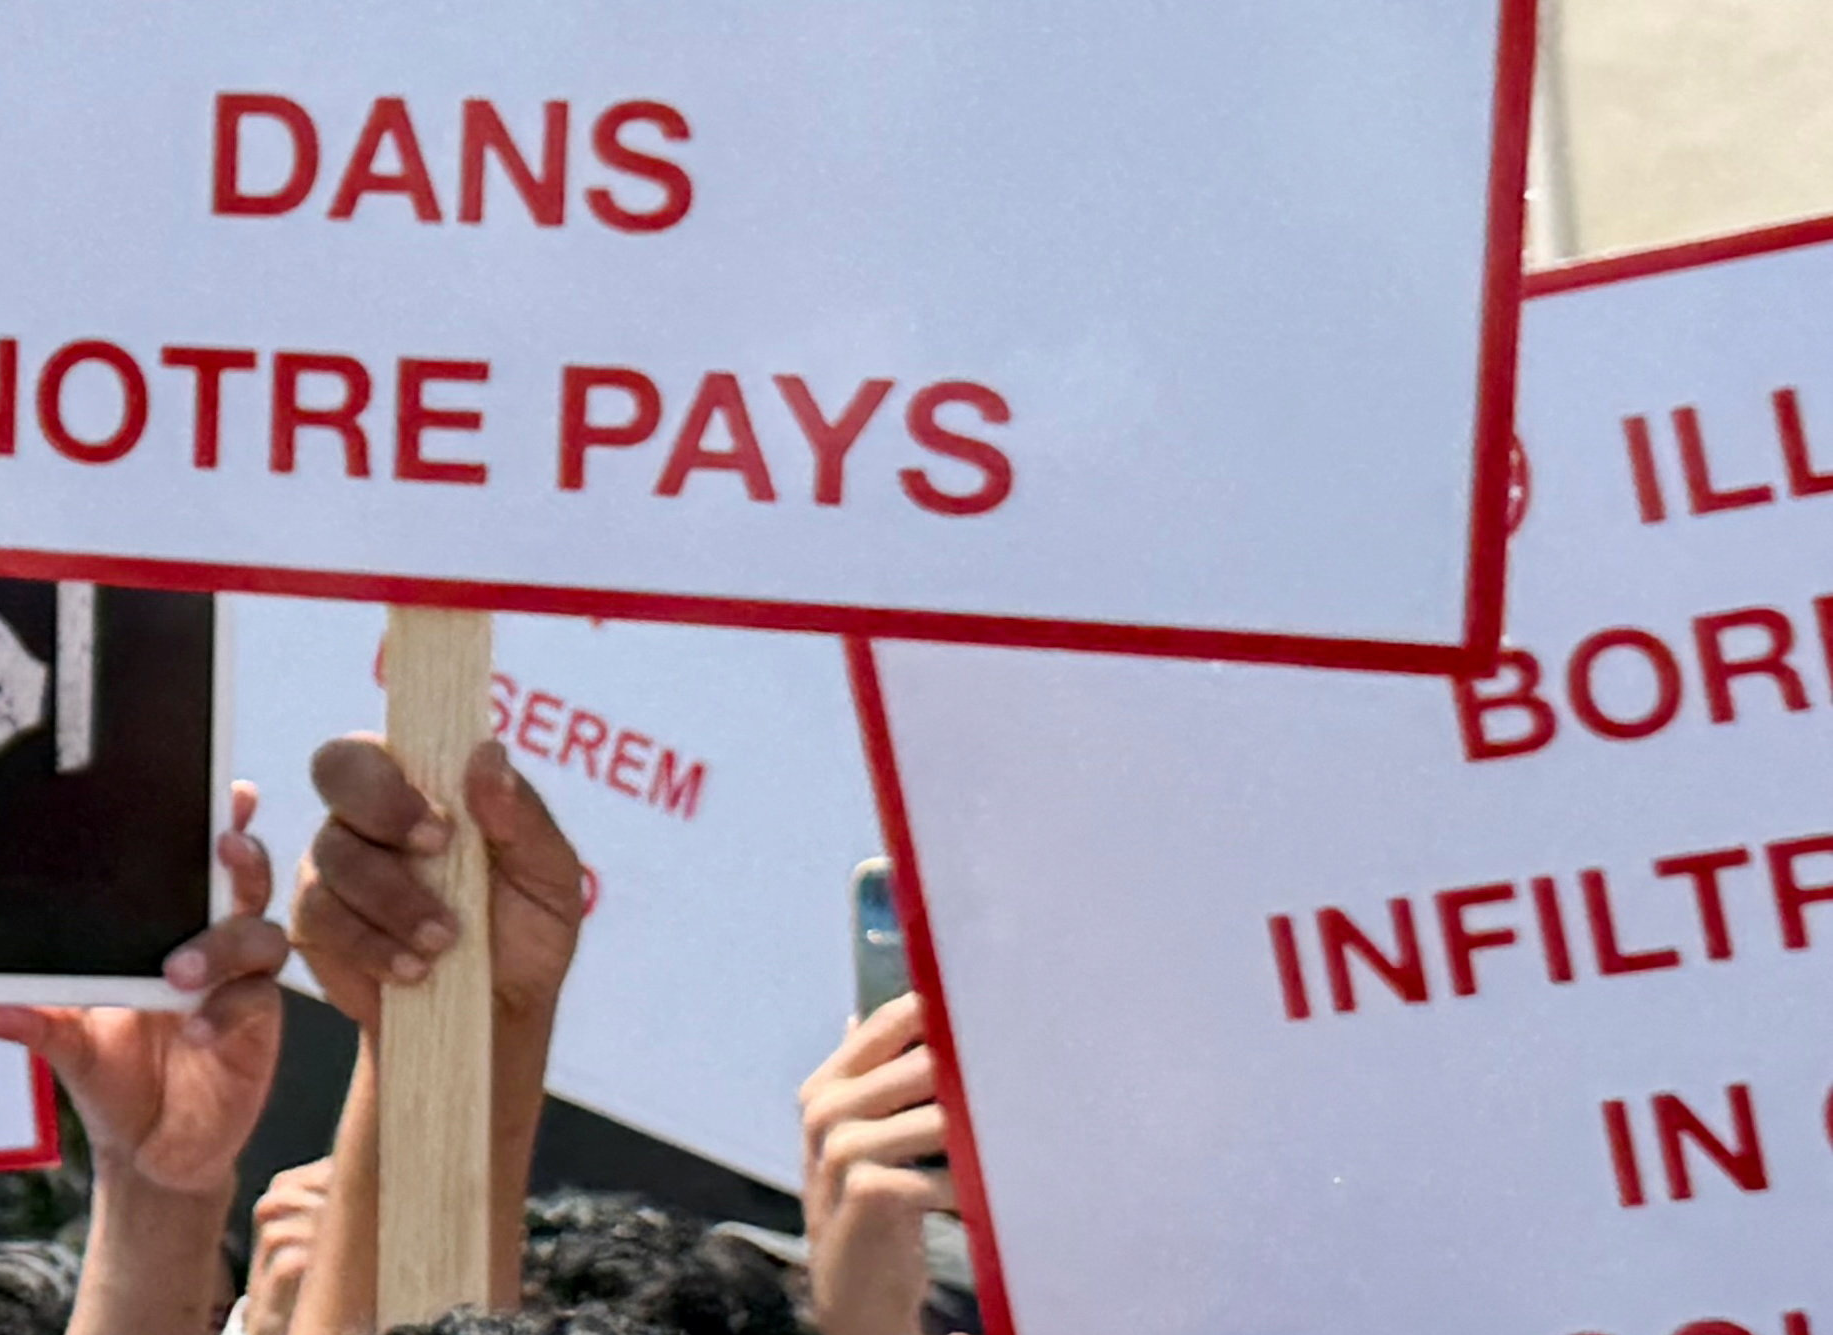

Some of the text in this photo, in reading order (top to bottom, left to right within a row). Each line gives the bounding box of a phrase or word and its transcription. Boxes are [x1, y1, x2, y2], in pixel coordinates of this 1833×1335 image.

[213, 93, 694, 233] DANS
[559, 365, 1013, 517] PAYS
[1454, 594, 1833, 764] BOR
[1602, 1082, 1770, 1209] IN
